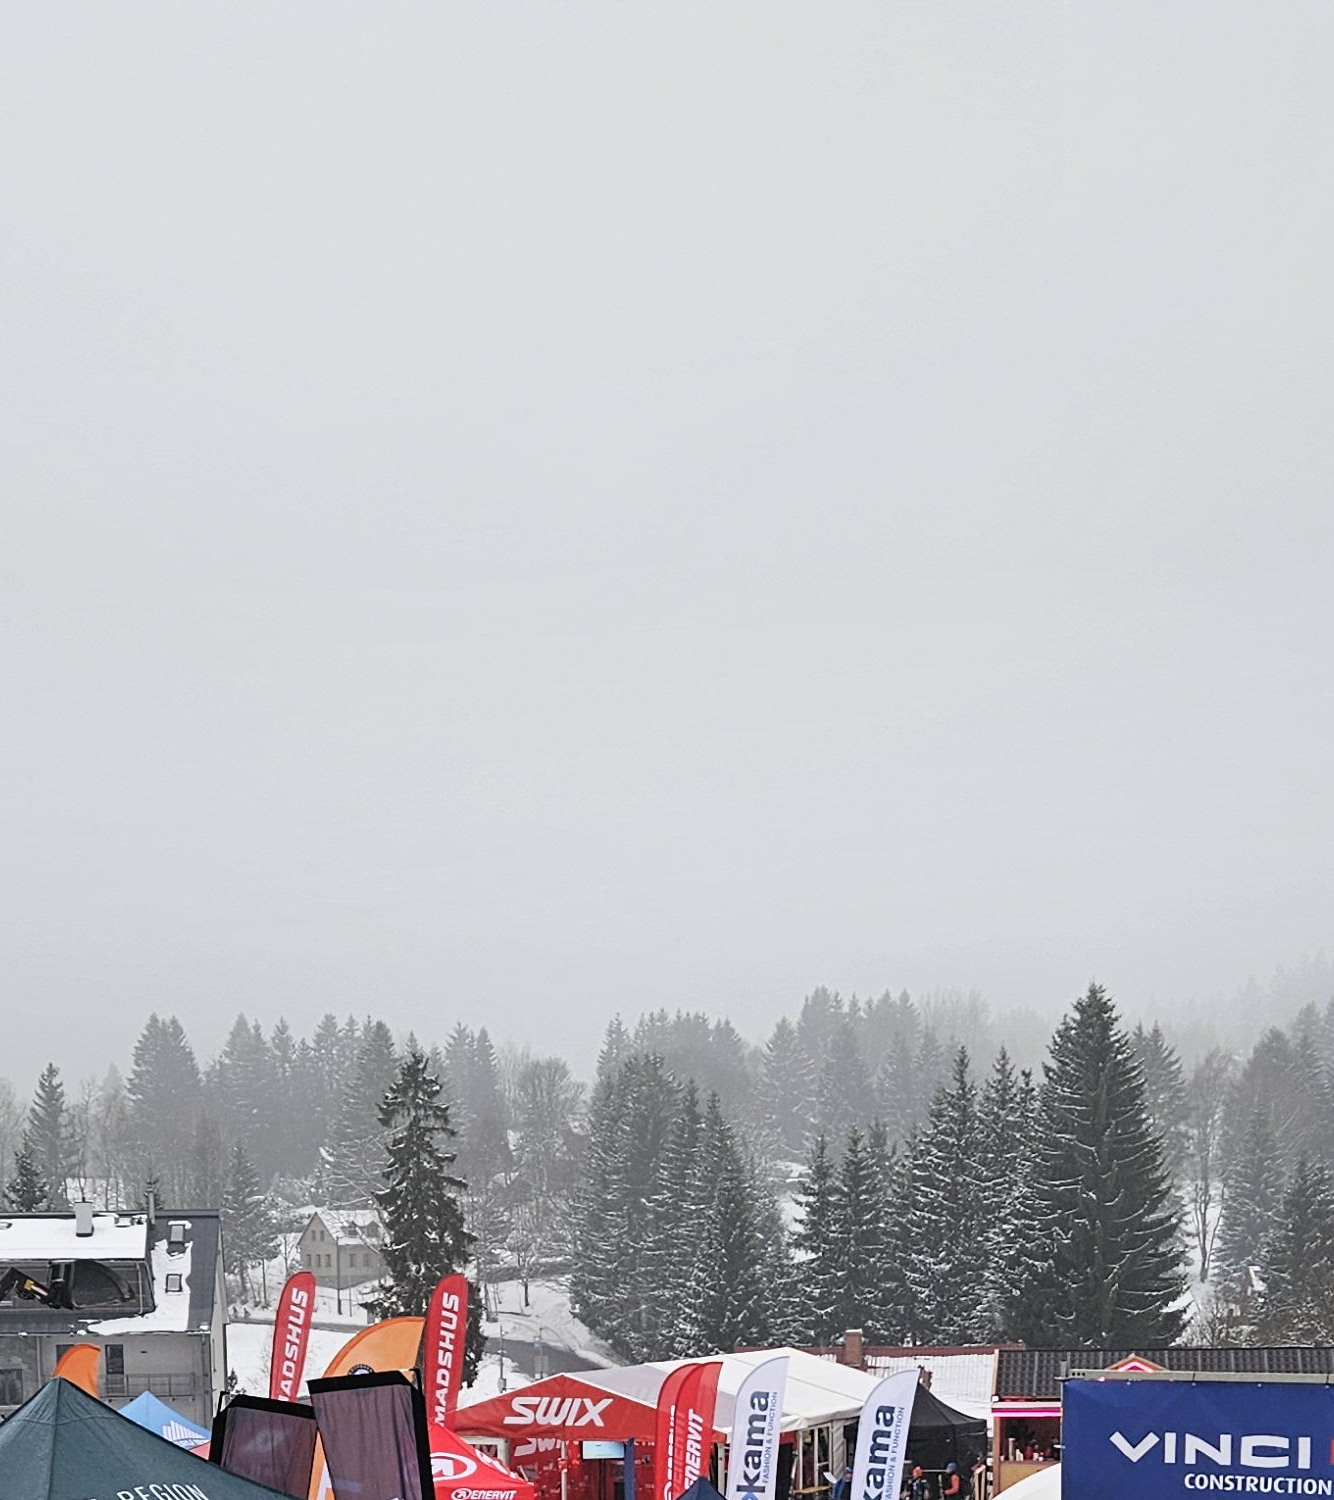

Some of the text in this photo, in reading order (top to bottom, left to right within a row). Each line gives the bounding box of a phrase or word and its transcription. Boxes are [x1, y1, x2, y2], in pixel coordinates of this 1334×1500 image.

[434, 1291, 460, 1426] MADSHUS
[503, 1397, 613, 1427] SWIX
[767, 1391, 778, 1436] FUNCTION
[892, 1406, 905, 1454] FUNCTION
[737, 1390, 770, 1494] kama
[1108, 1431, 1312, 1470] VINCI
[763, 1447, 773, 1484] FASHION
[1184, 1473, 1333, 1496] CONSTRUCTION
[470, 1490, 517, 1500] ENERVIT
